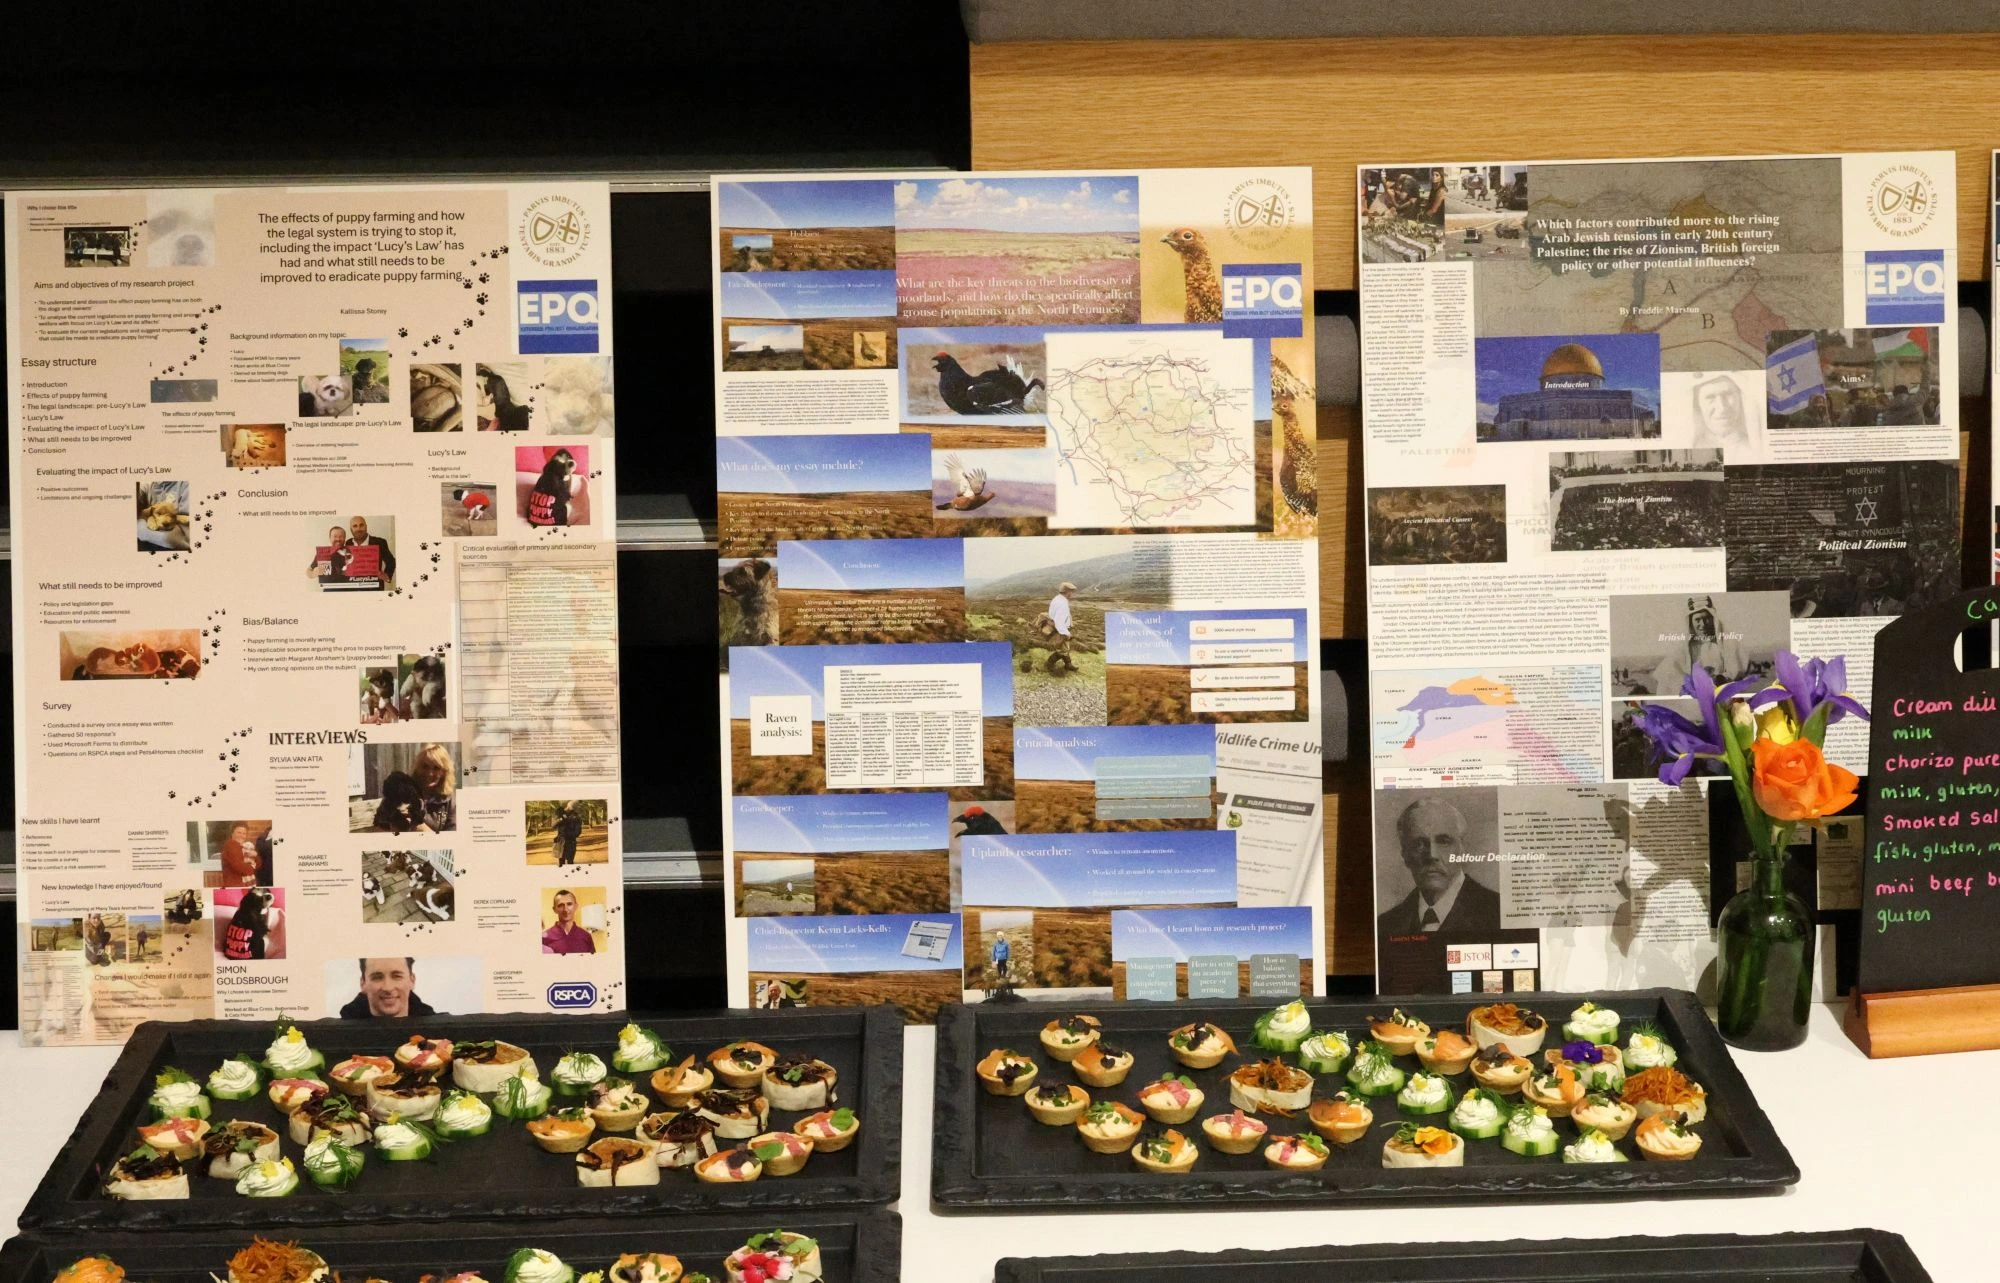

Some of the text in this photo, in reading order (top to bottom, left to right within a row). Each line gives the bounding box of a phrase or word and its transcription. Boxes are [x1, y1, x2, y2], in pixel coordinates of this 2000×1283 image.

[257, 210, 464, 224] The effects of puppy farming and how
[1536, 213, 1779, 230] Which factors contributed more to the rising
[266, 225, 456, 240] the legal system is trying to stop it,
[1542, 228, 1773, 243] Arab Jewish tensions in early 20th century
[259, 239, 464, 255] including the impact 'Lucy's Law' has
[1536, 241, 1779, 257] Palestine; the rise of Zionism, British foreign
[280, 254, 444, 267] had and what still needs to be
[1561, 255, 1755, 274] policy or other potential influences?
[70, 280, 109, 289] objectives
[119, 281, 132, 289] my
[166, 279, 194, 288] project
[260, 269, 465, 284] improved to eradicate puppy farming.
[896, 273, 1133, 289] What are the key threats to the biodiversity of
[1866, 262, 1944, 295] EPQ
[1223, 276, 1302, 309] EPQ
[1663, 279, 1677, 295] A
[896, 290, 954, 303] moorlands,
[956, 291, 976, 302] and
[979, 288, 1000, 301] how
[1004, 288, 1018, 301] do
[1021, 288, 1043, 304] they
[1043, 289, 1102, 302] specifically
[1103, 287, 1132, 300] affect
[519, 292, 599, 325] EPQ
[902, 301, 1127, 318] grouse populations in the North Pennines?
[1618, 306, 1629, 317] By
[1701, 314, 1715, 329] B
[21, 357, 96, 368] Essay structure
[1544, 380, 1589, 389] Introduction
[1840, 374, 1866, 384] Aims?
[427, 449, 450, 457] Lucy's
[36, 467, 76, 477] Evaluating
[77, 467, 90, 475] the
[91, 467, 118, 475] impact
[119, 466, 128, 474] of
[128, 466, 153, 475] Lucy's
[237, 488, 288, 498] Conclusion
[1846, 485, 1885, 495] PROTEST
[1818, 538, 1906, 550] Political Zionism
[242, 616, 298, 625] Bias/Balance
[1658, 633, 1686, 641] British
[1718, 632, 1744, 642] Policy
[42, 701, 71, 711] Survey
[1893, 691, 1997, 717] Cream dill
[765, 712, 796, 722] Raven
[269, 729, 367, 746] INTERVIEWS
[760, 726, 803, 739] analysis:
[1892, 725, 1932, 740] milk
[1017, 737, 1097, 752] Critical analysis:
[1214, 732, 1257, 748] ildlife
[1259, 737, 1300, 753] Crime
[269, 755, 292, 763] SYLVIA
[1963, 754, 2000, 776] pure
[1881, 783, 2000, 802] milk, gluten,
[1883, 811, 1960, 831] Smoked
[971, 846, 1072, 860] Uplands researcher:
[1448, 851, 1545, 863] Balfour Declaration
[1874, 841, 1982, 863] fish, gluten,
[1876, 875, 1974, 896] mini beef
[1877, 909, 1931, 933] gluten
[1462, 951, 1491, 961] JSTOR
[216, 965, 246, 974] SIMON
[216, 975, 288, 985] GOLDSBROUGH
[554, 989, 591, 1001] RSPCA
